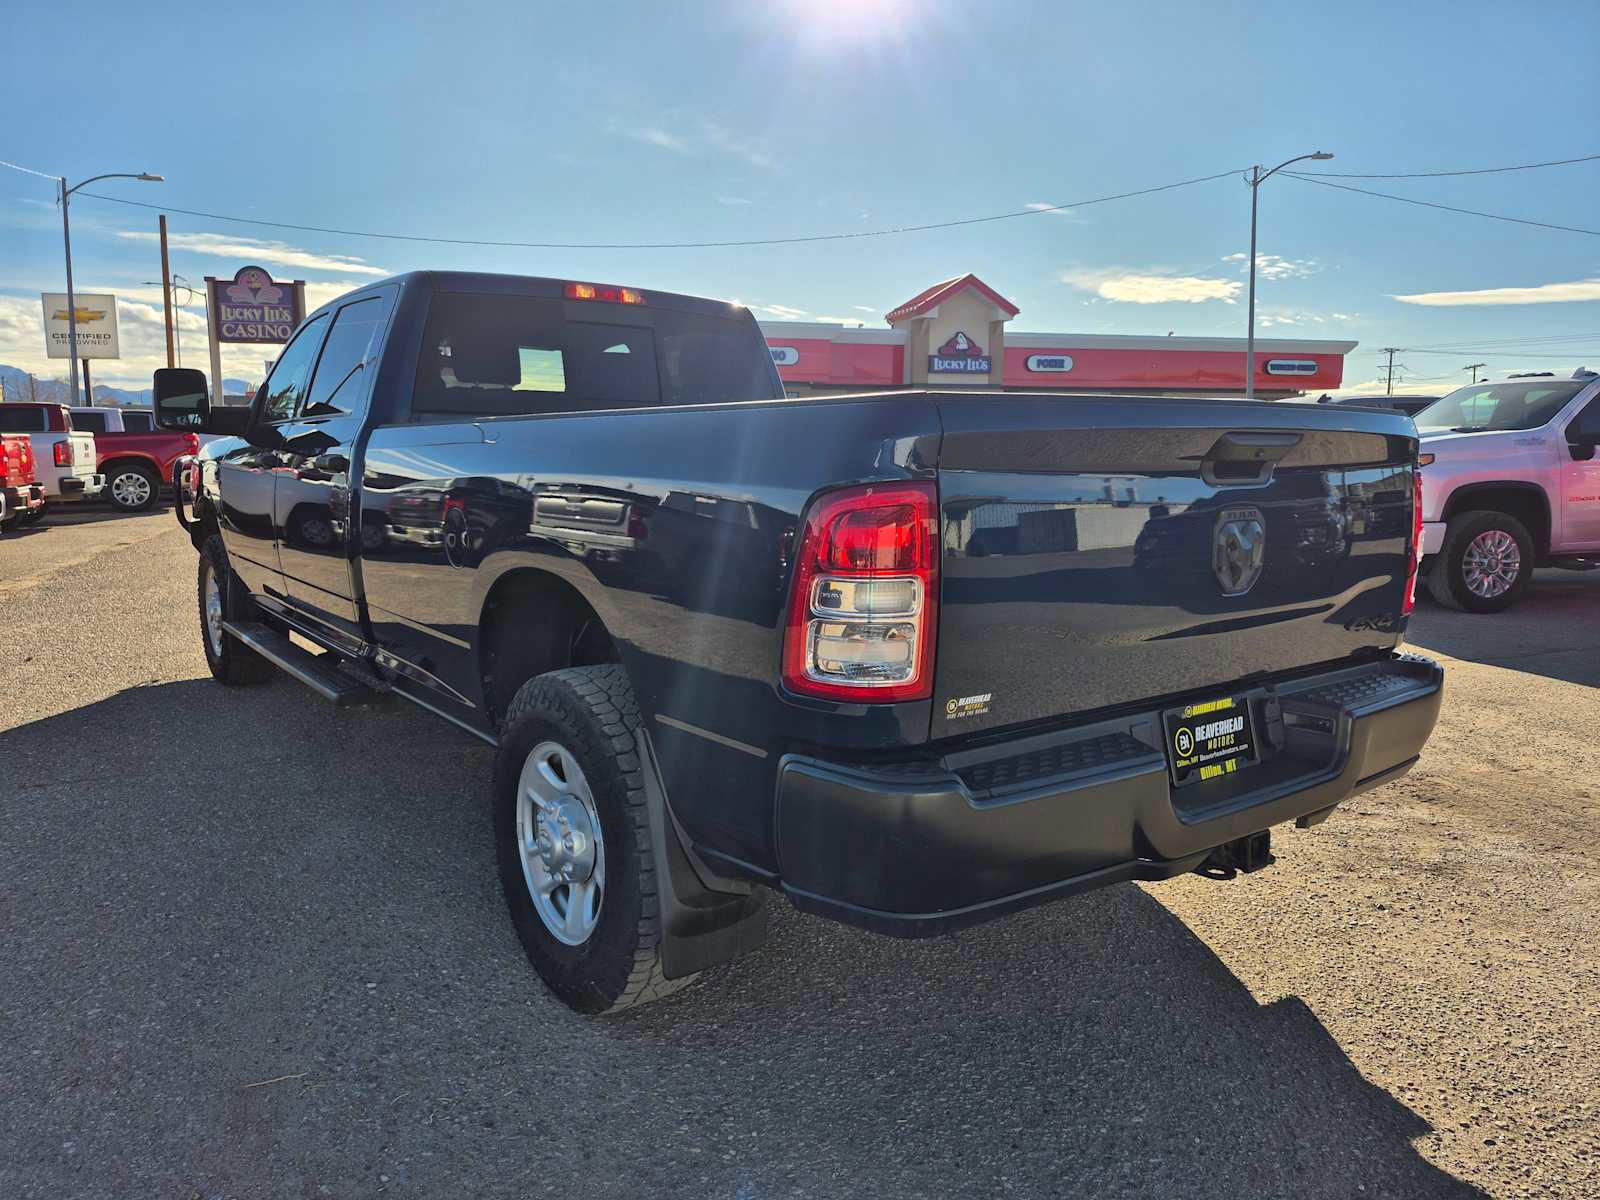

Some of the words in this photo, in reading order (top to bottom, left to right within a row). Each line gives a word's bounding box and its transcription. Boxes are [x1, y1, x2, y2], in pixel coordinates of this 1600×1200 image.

[222, 323, 292, 339] CASINO
[1195, 716, 1244, 742] BEAVERHEAD
[1207, 734, 1235, 751] MOTORS
[1225, 758, 1237, 773] MT
